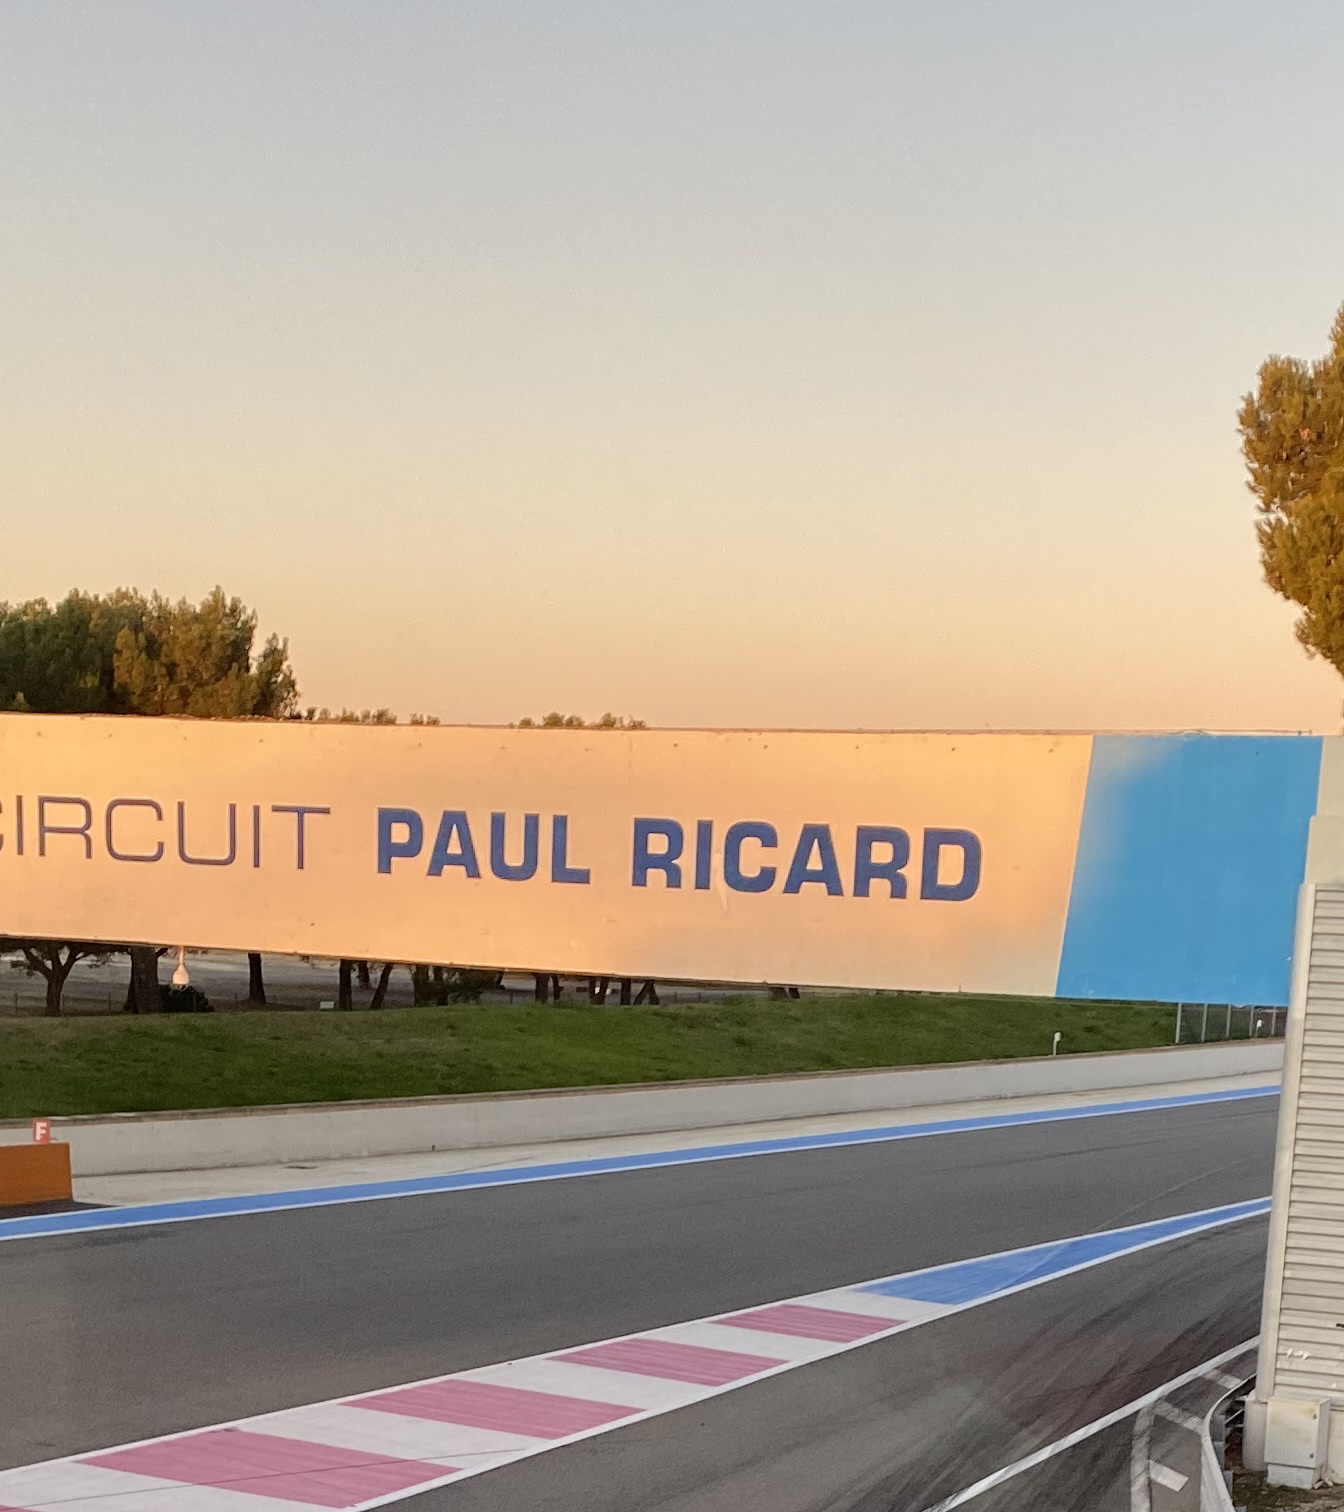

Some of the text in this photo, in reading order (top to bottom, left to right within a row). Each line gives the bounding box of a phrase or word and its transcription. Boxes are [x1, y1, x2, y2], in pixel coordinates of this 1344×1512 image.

[376, 806, 591, 886] PAUL
[631, 816, 983, 901] RICARD
[35, 1121, 47, 1141] F
